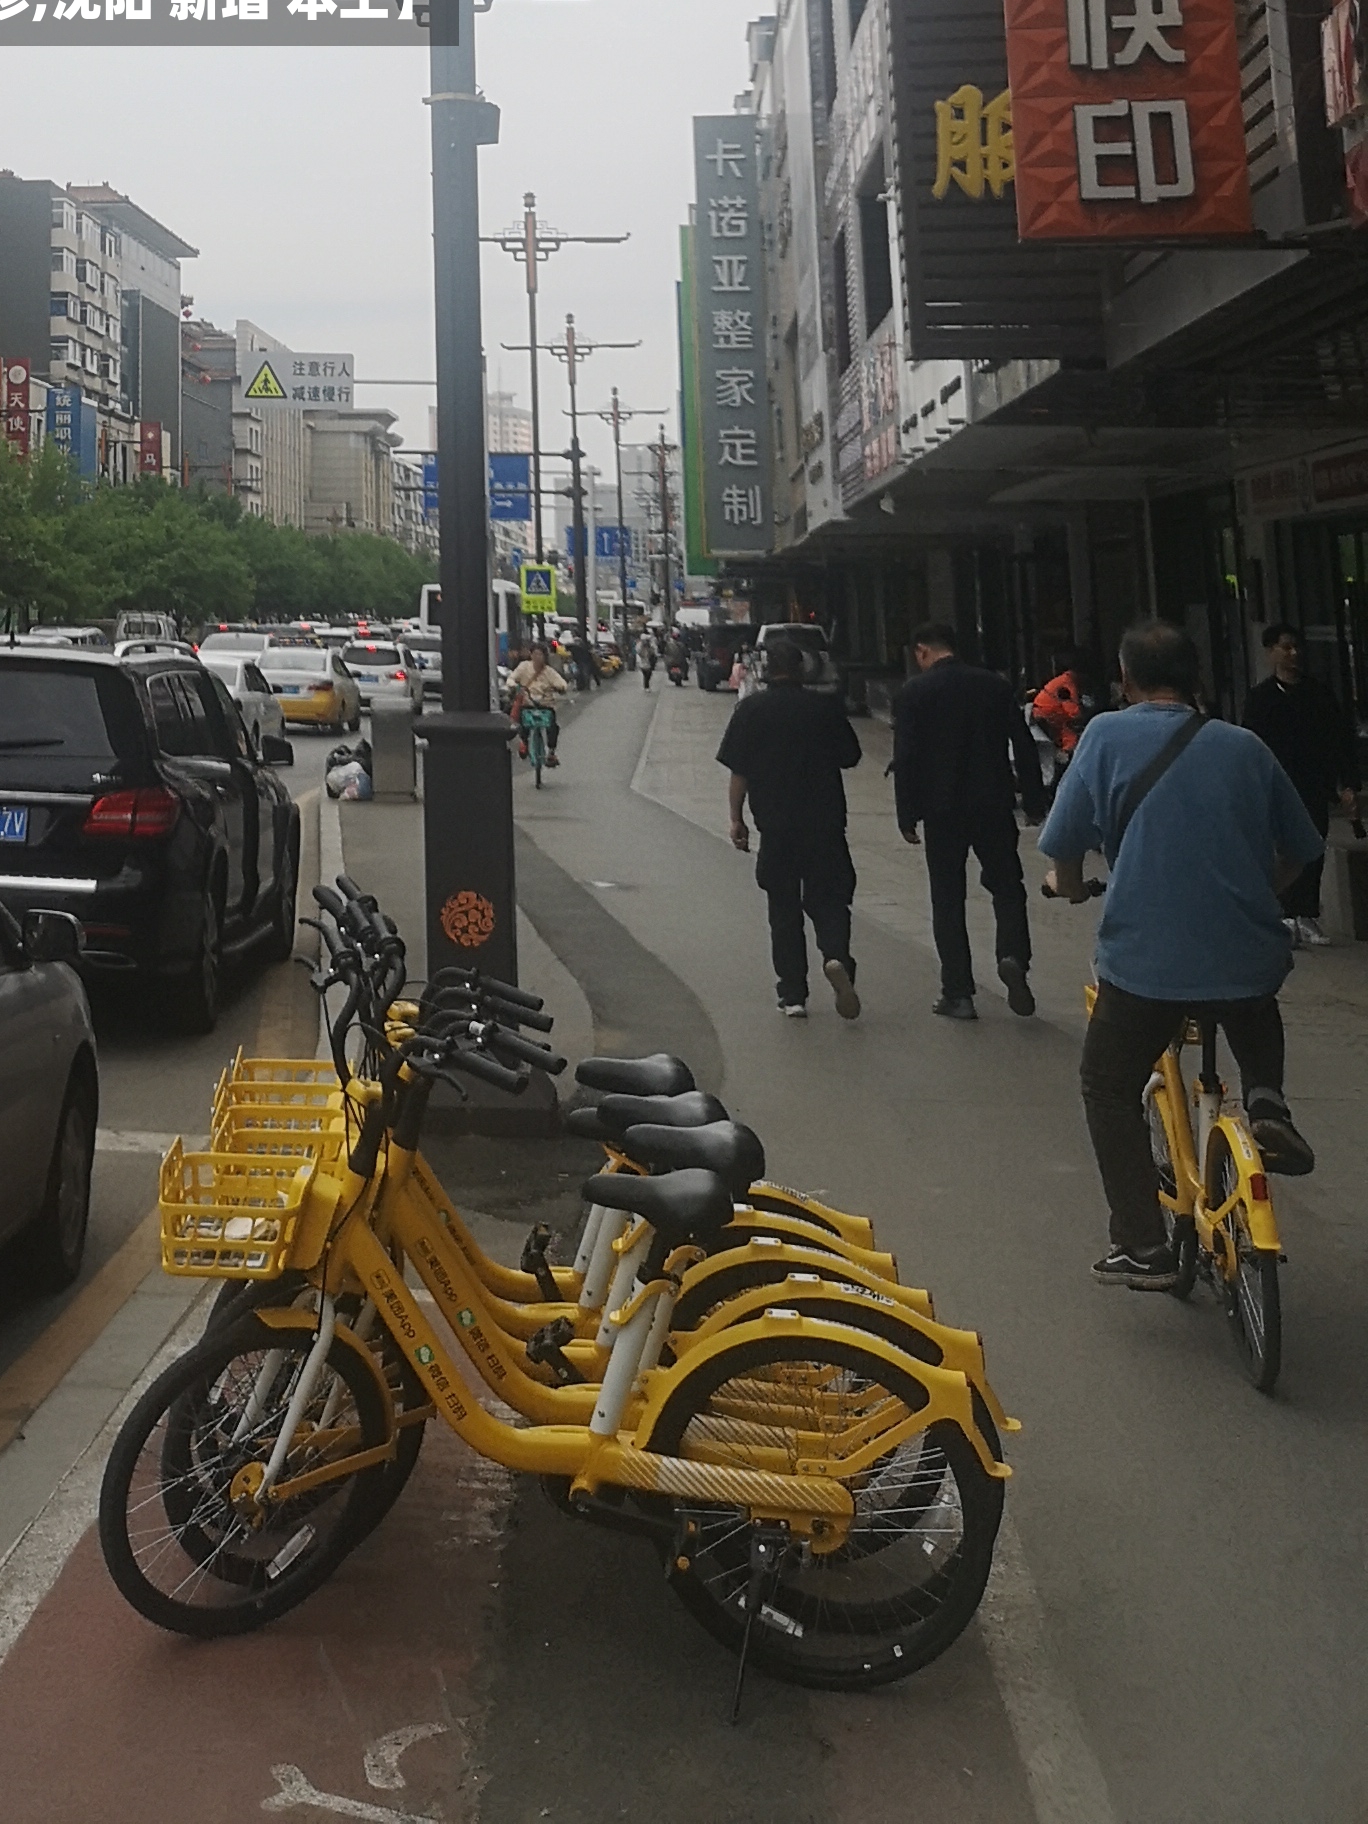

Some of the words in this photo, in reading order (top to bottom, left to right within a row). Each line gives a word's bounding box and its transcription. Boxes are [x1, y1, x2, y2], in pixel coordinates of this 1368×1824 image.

[292, 361, 350, 377] 注意行人
[705, 137, 763, 527] 卡诺亚整家定制
